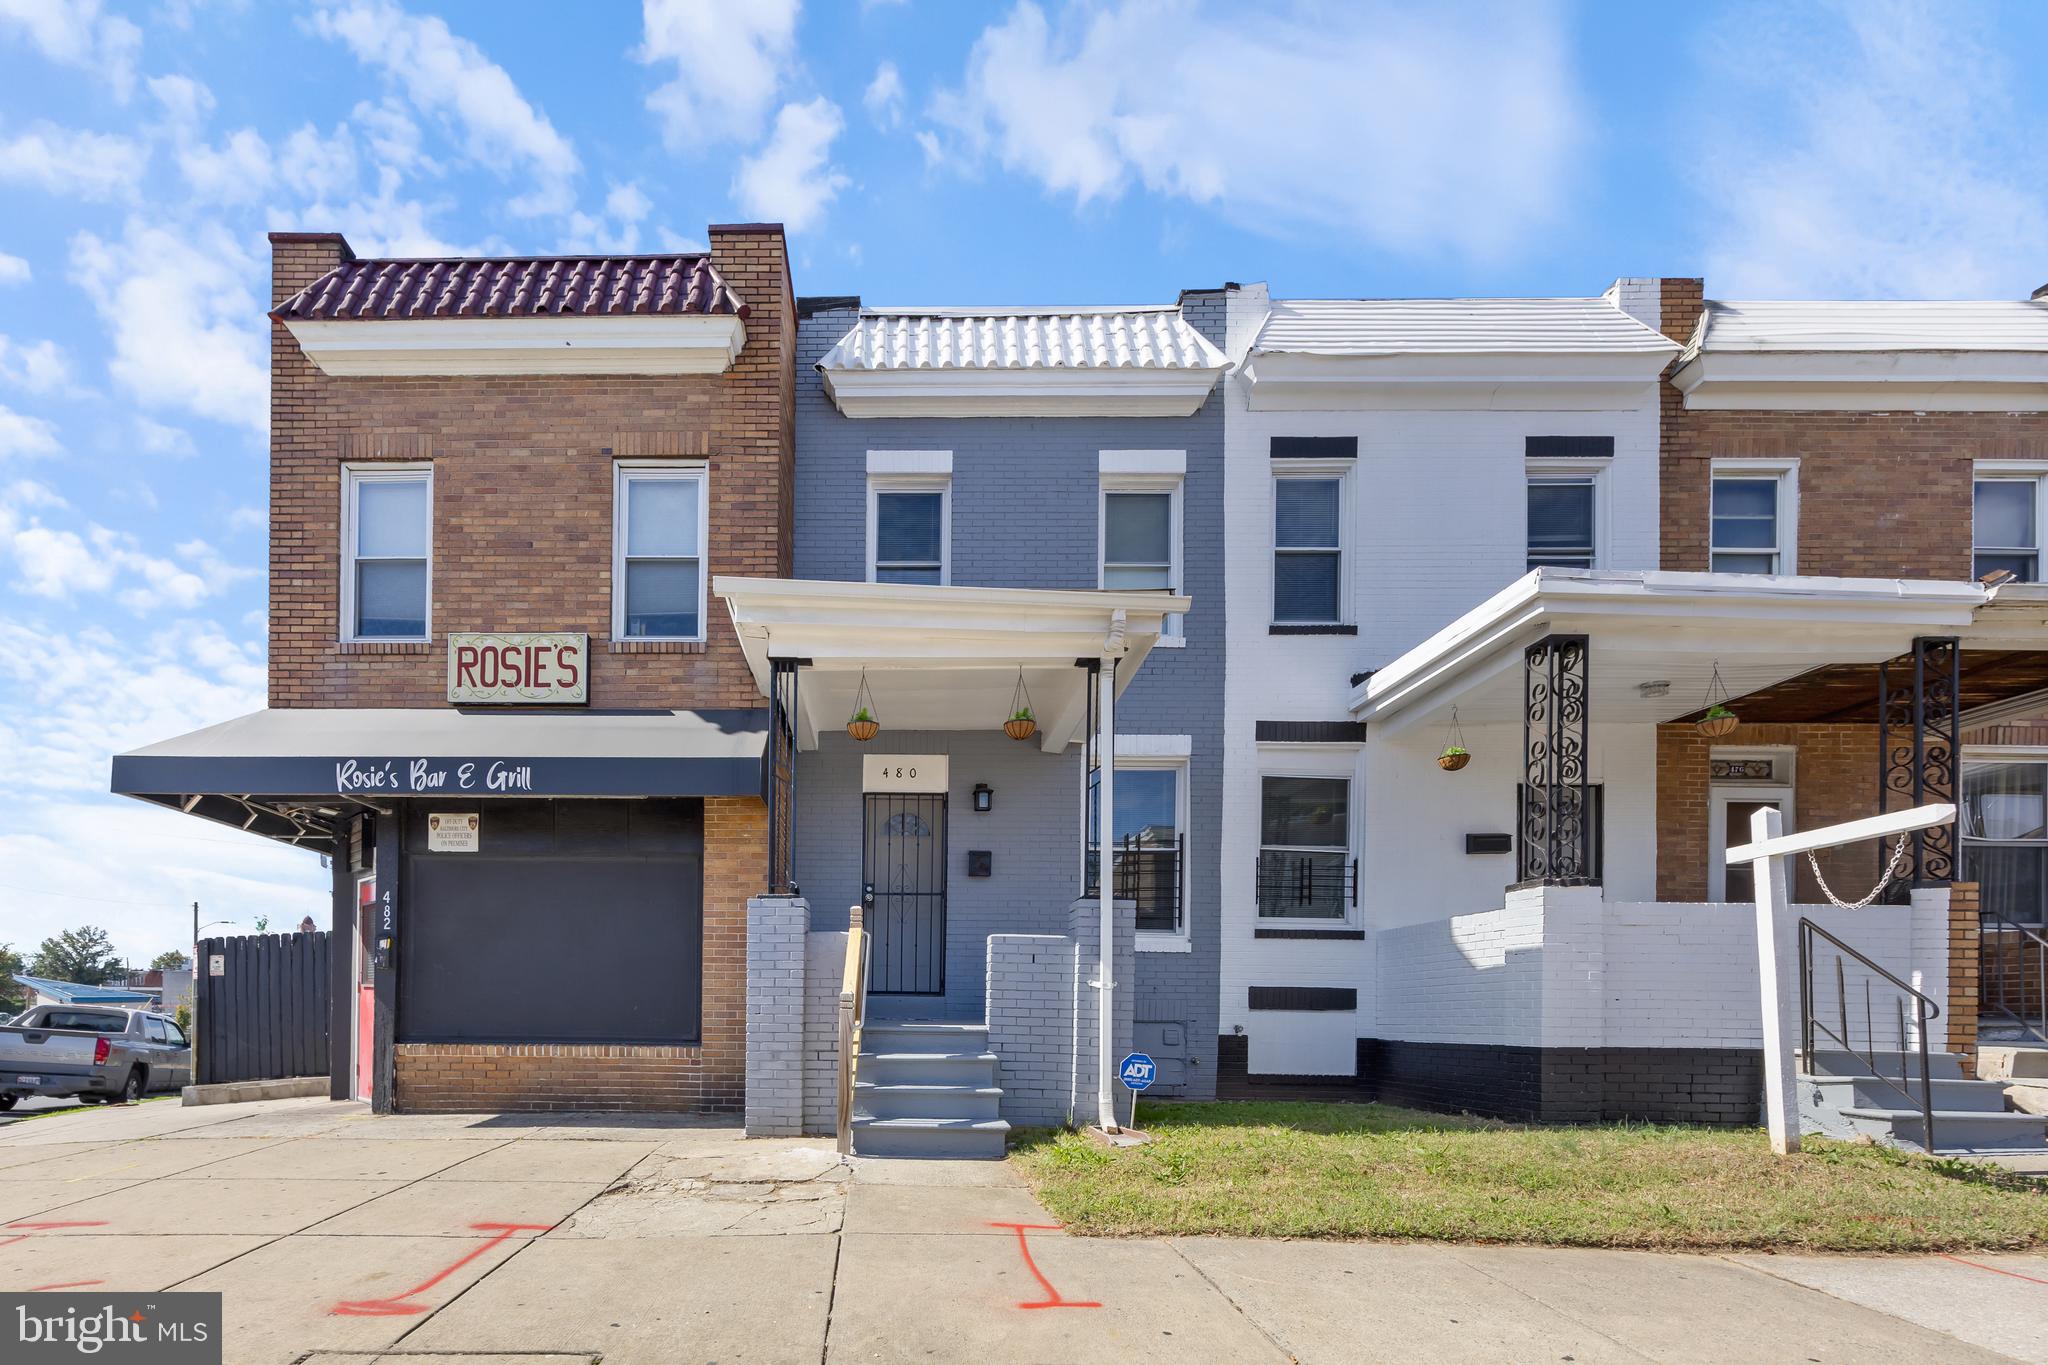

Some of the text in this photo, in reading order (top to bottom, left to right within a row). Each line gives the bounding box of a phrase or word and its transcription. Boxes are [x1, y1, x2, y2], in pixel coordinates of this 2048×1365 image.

[457, 644, 578, 688] ROSIE'S
[336, 759, 399, 792] Rosie's
[410, 758, 447, 791] Bar
[486, 761, 532, 791] Grill
[883, 767, 917, 779] 480
[1123, 1063, 1152, 1078] ADT
